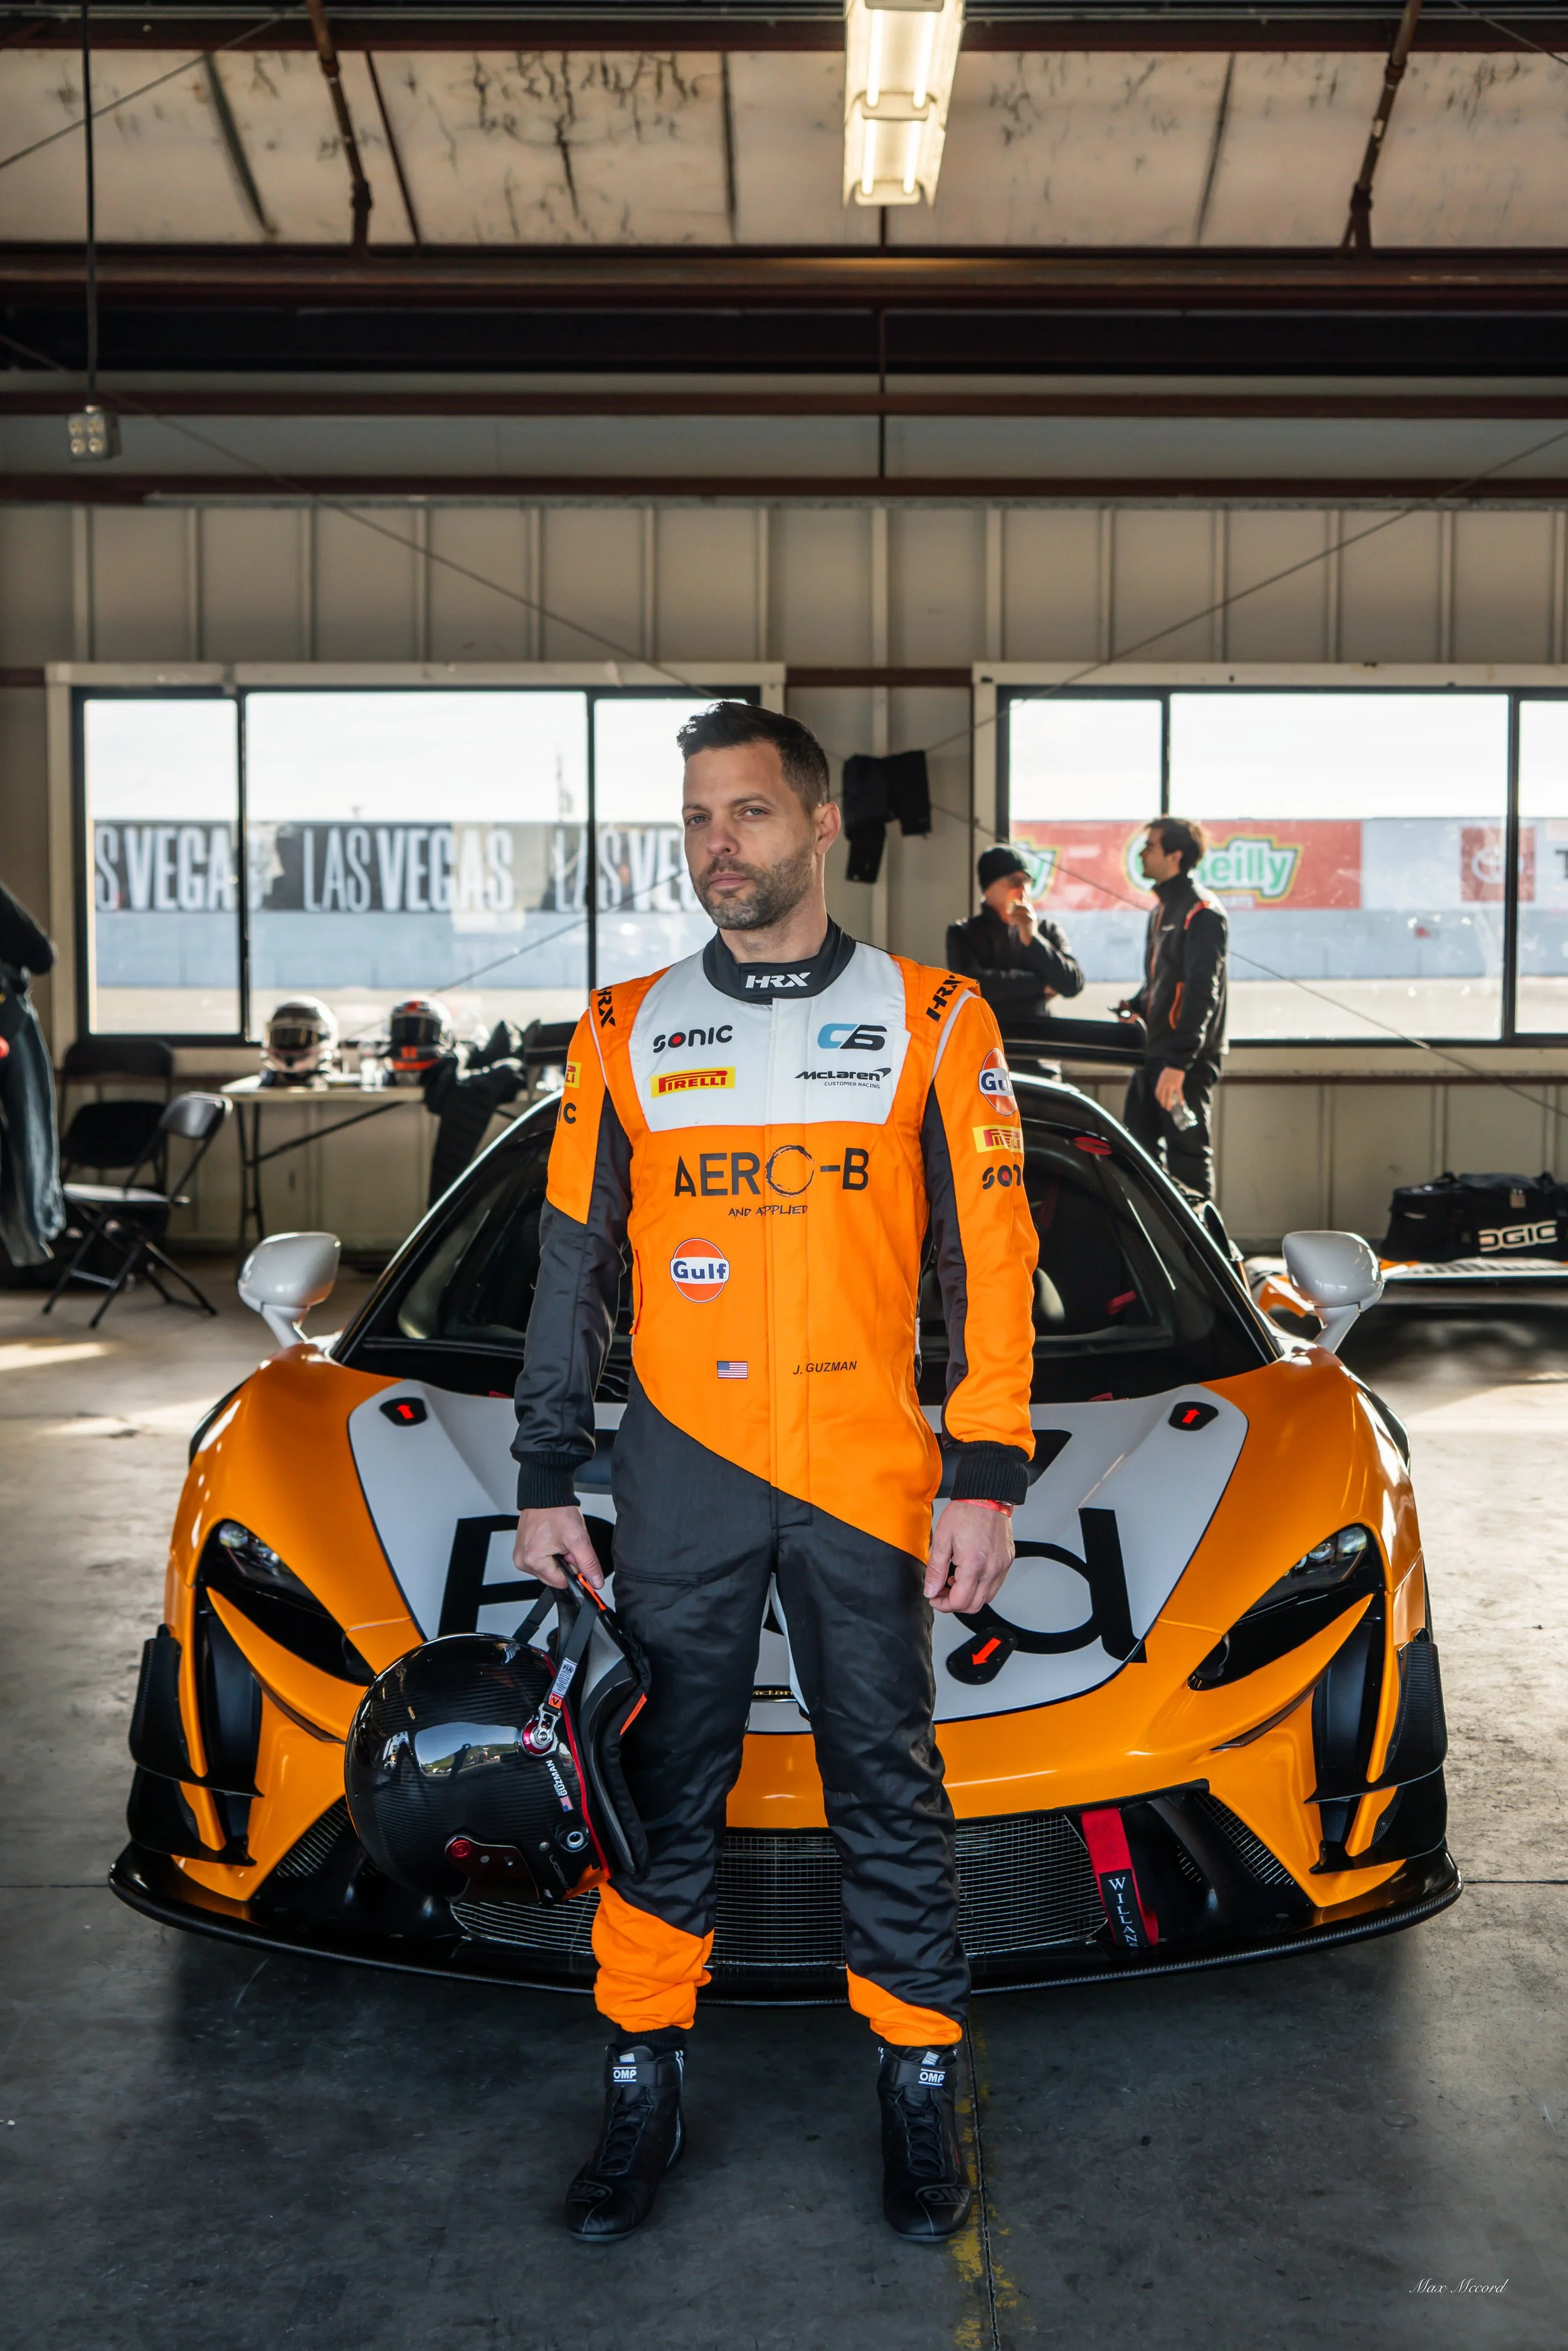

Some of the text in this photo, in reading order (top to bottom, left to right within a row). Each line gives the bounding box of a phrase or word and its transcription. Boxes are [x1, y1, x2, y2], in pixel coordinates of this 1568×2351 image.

[304, 826, 514, 912] LAS VEGAS
[745, 972, 811, 989] HRX
[659, 1070, 728, 1093] PIRELLI
[794, 1069, 881, 1082] McLaren
[728, 1204, 808, 1219] AND APPLIED
[673, 1261, 727, 1280] Gulf
[793, 1361, 857, 1375] J. GUZMAN
[546, 1759, 568, 1796] GUZMAN
[613, 2069, 637, 2079] OMP
[919, 2071, 945, 2083] OMP
